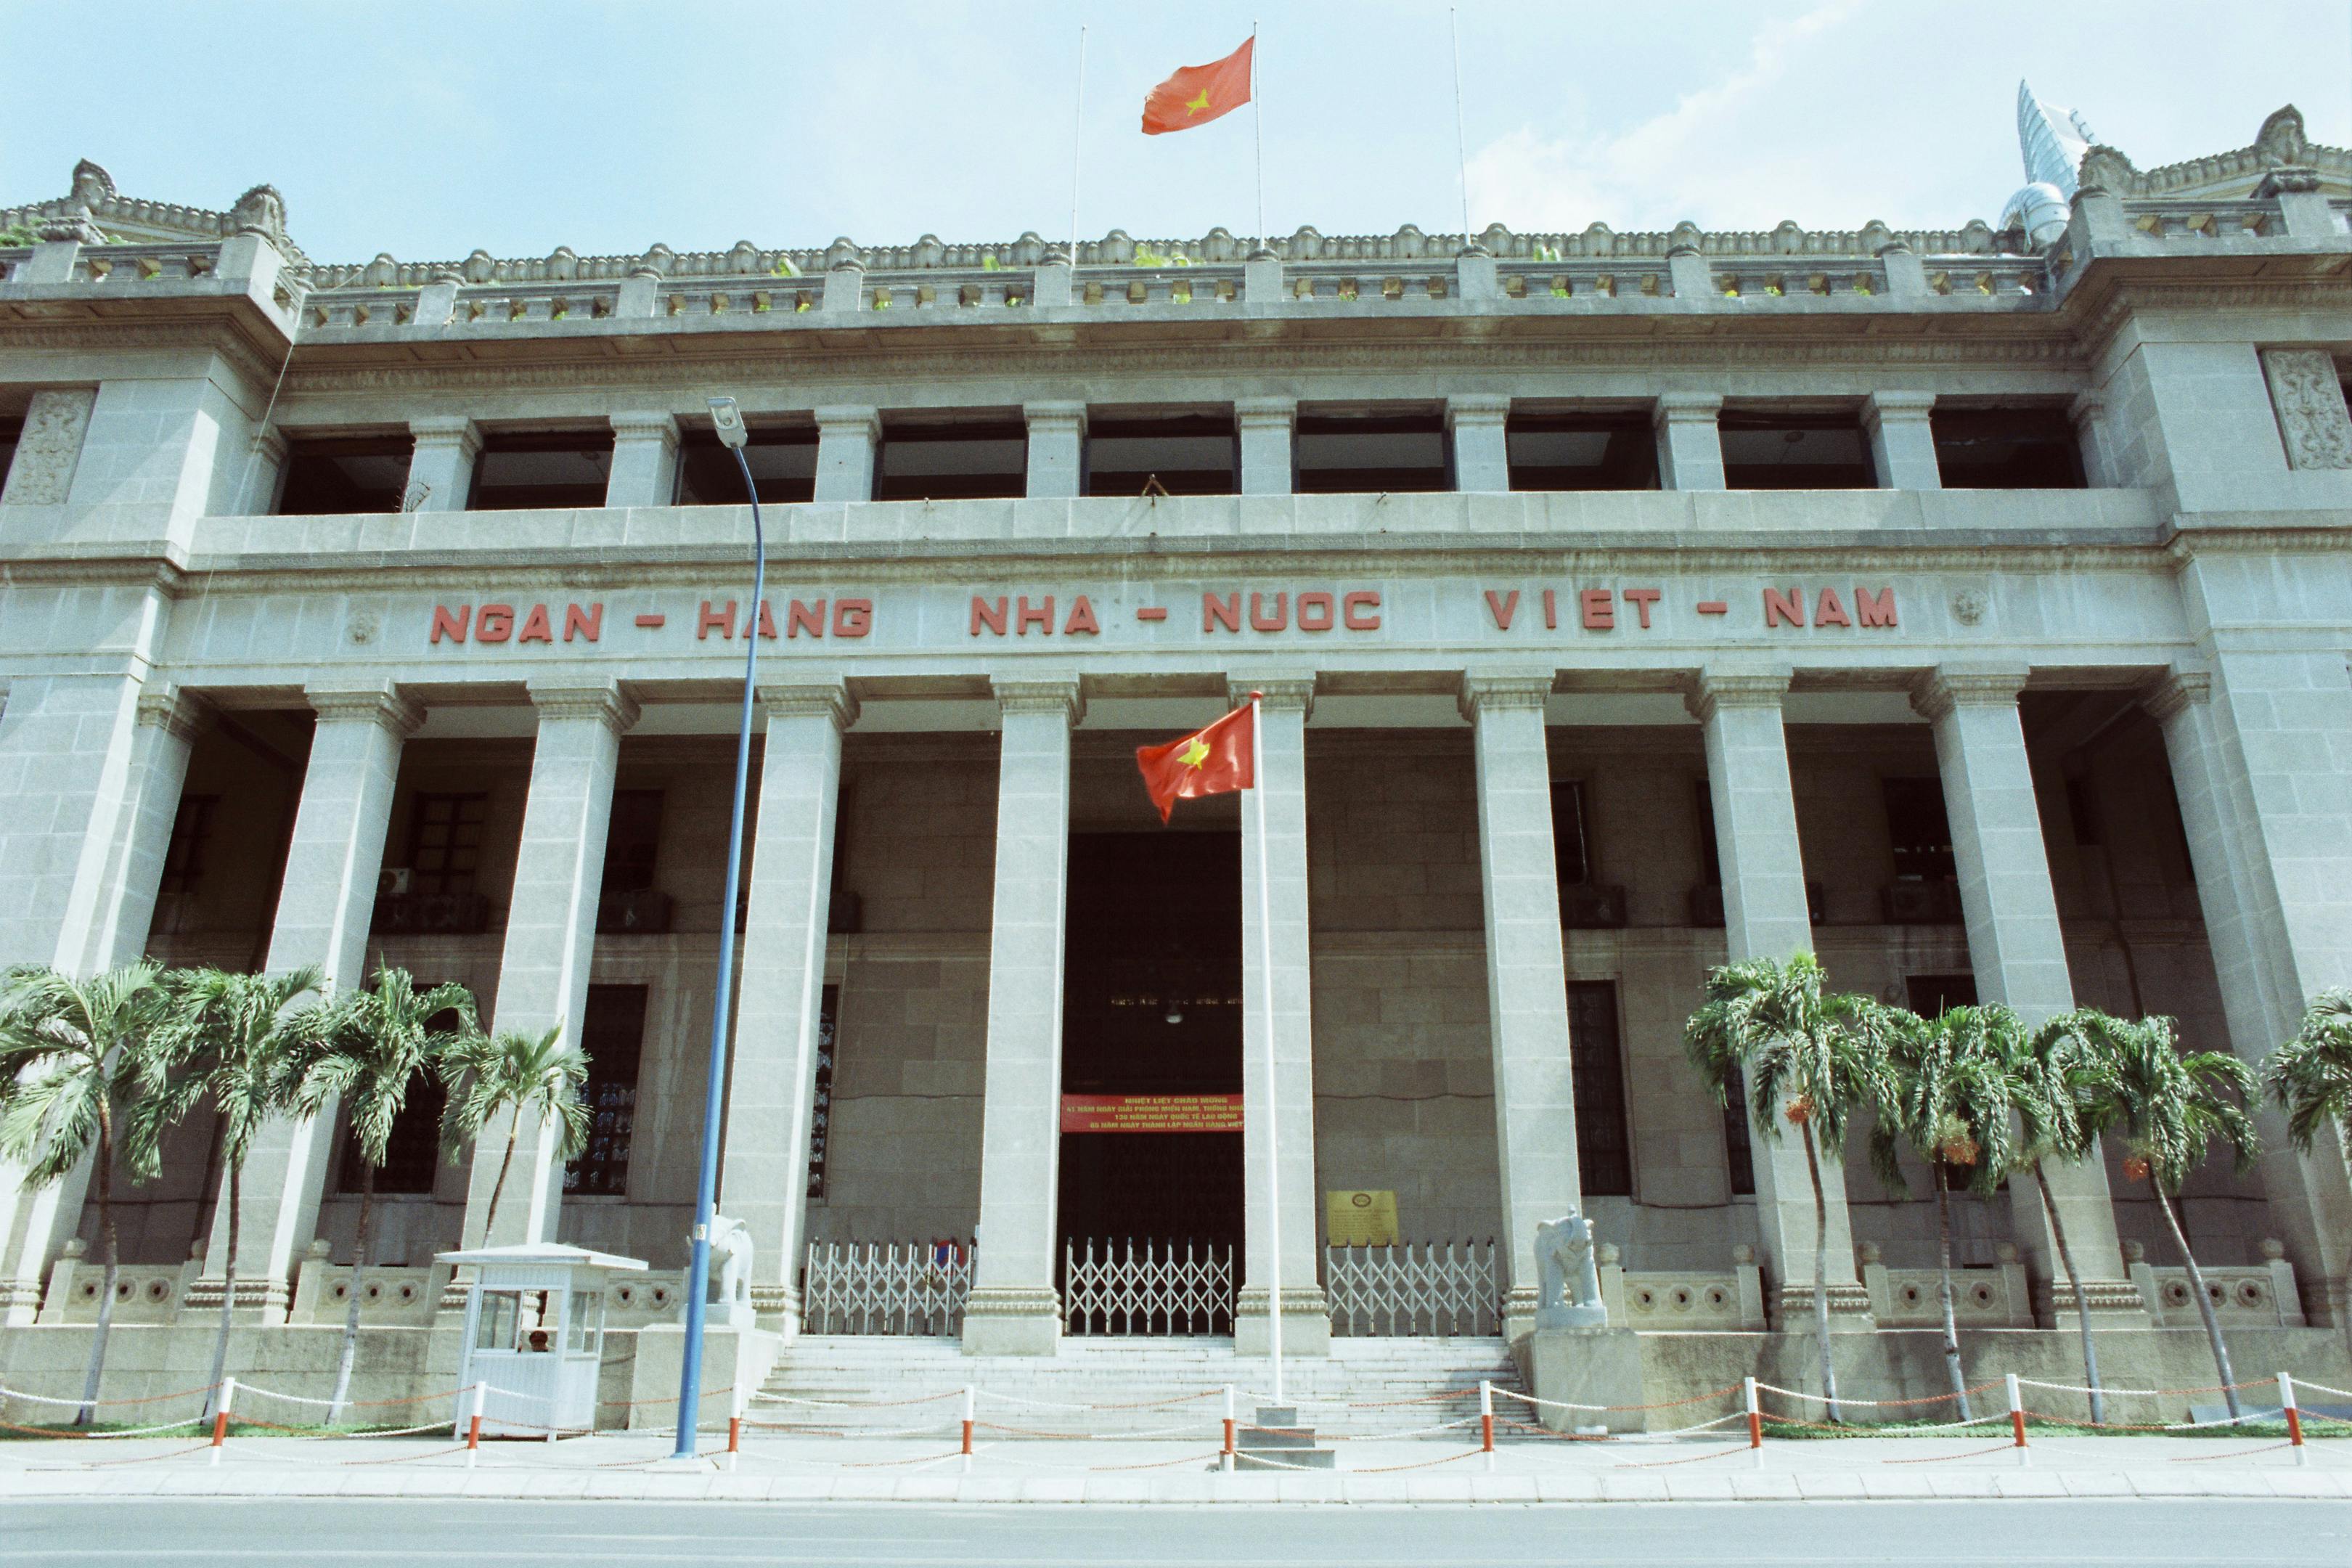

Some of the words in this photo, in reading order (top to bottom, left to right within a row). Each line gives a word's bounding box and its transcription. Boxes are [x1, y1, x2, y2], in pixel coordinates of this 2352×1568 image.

[430, 603, 603, 644] NGAN
[698, 599, 873, 640] HANG
[971, 595, 1099, 636] NHA
[1204, 592, 1381, 633] NUOC
[1485, 589, 1661, 631] VIET
[1763, 588, 1897, 628] NAM
